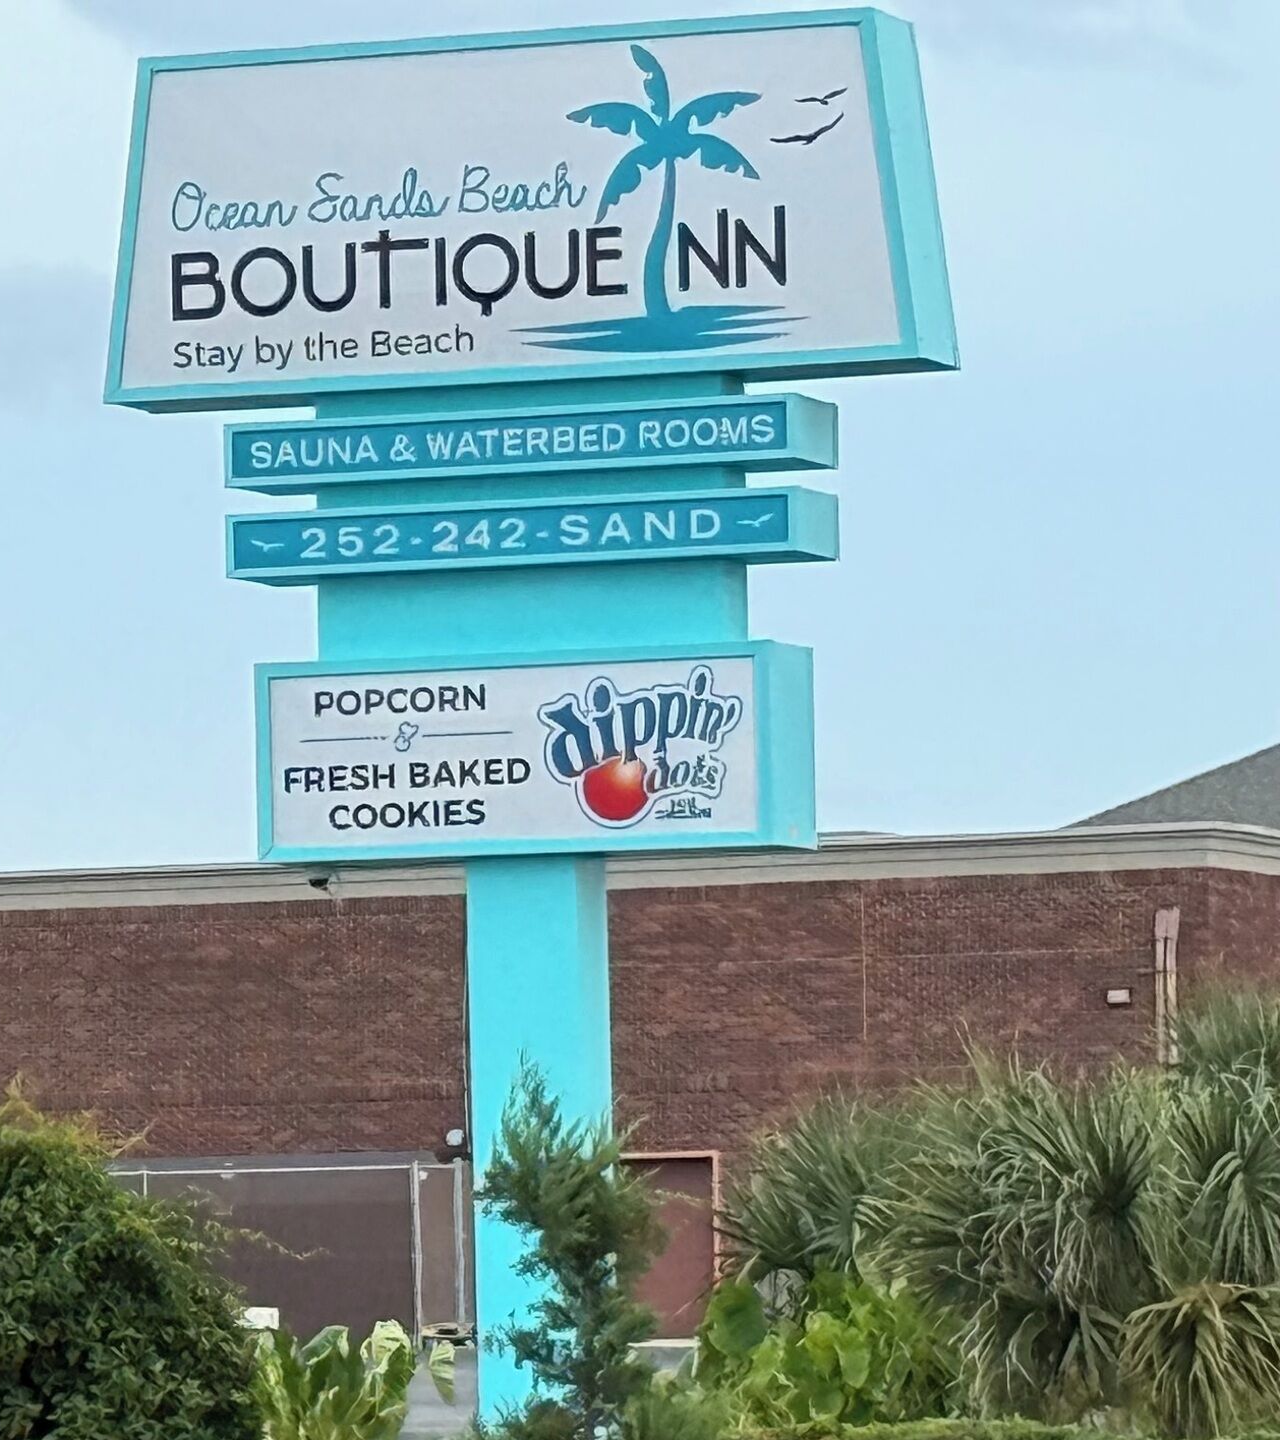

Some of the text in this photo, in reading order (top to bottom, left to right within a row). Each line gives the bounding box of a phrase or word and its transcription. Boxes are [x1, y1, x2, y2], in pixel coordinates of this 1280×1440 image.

[171, 162, 587, 232] Ocean Sands Beach
[171, 226, 628, 321] BOUTIQUE
[172, 324, 474, 373] Stay by the Beach
[251, 414, 776, 469] SAUNA & WATERBED ROOMS
[314, 684, 486, 717] POPCORN
[284, 757, 531, 793] FRESH BAKED
[328, 799, 486, 830] COOKIES
